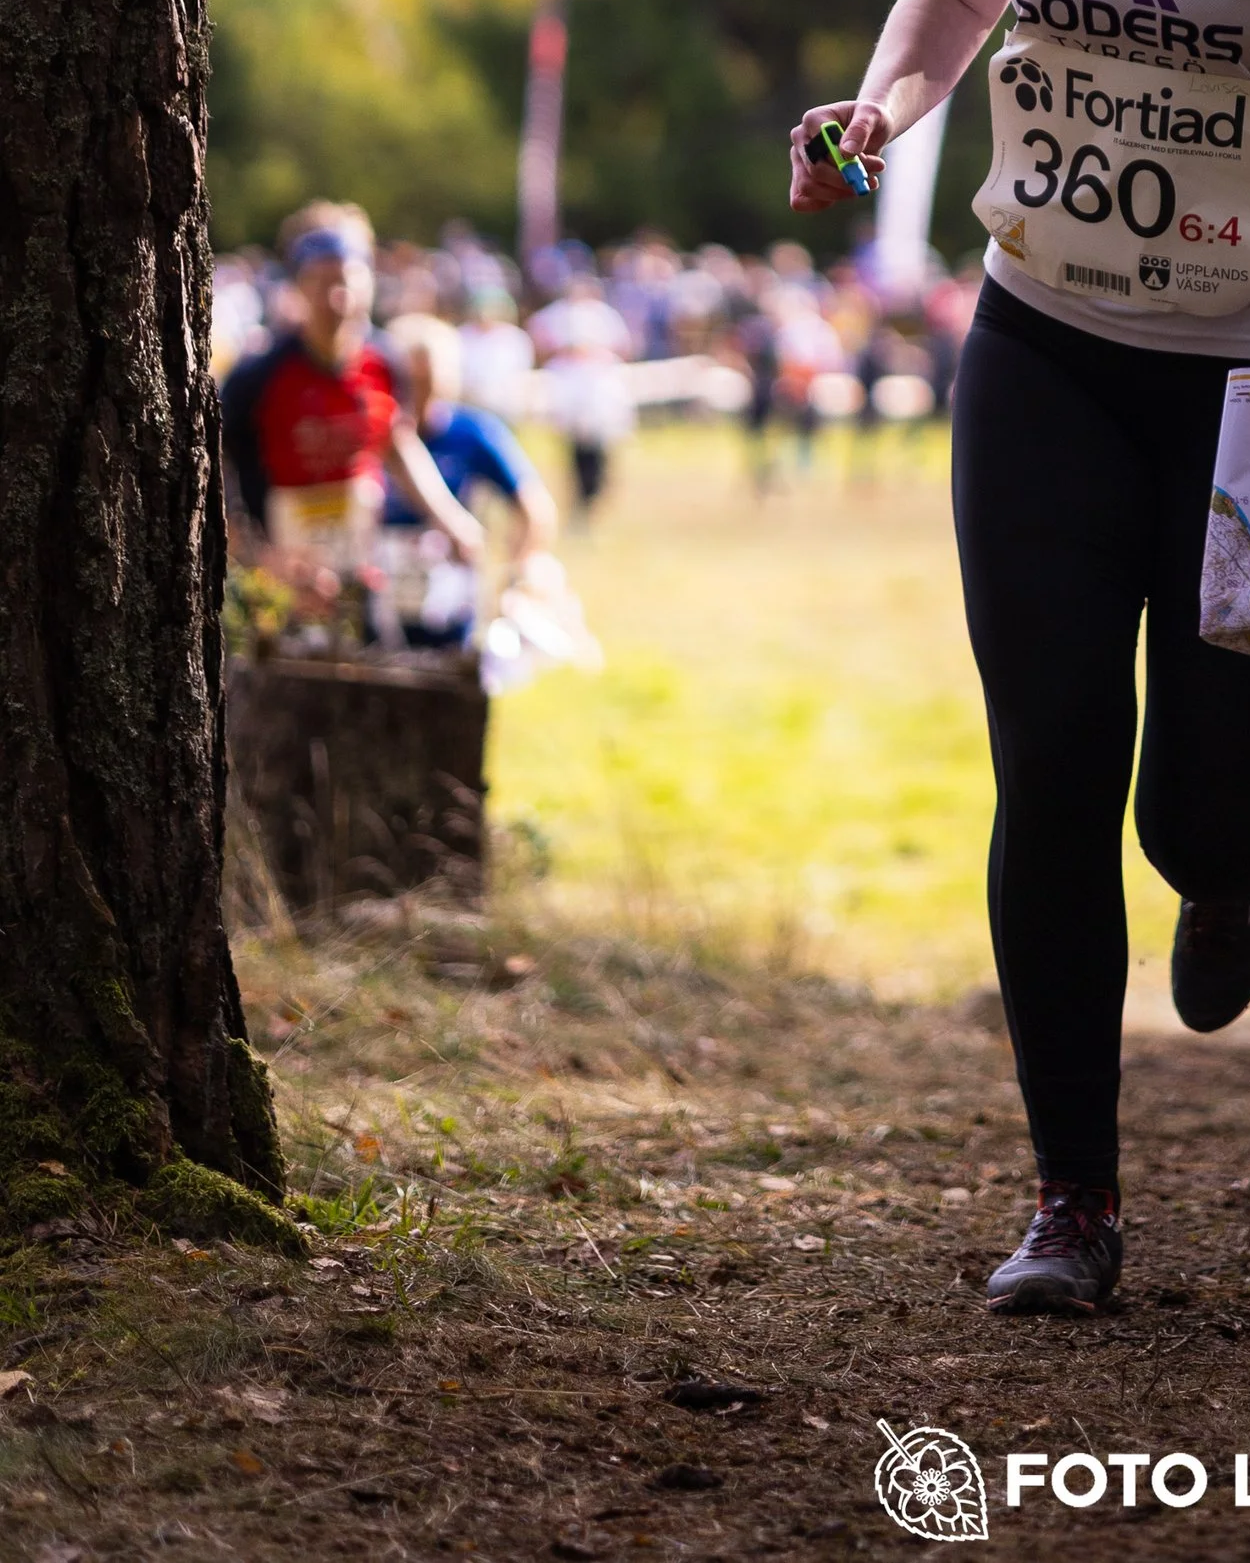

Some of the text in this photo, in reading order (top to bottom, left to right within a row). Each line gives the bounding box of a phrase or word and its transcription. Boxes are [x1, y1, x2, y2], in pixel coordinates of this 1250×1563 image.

[1066, 68, 1246, 150] Fortiad
[1151, 145, 1166, 154] MED
[1167, 147, 1214, 158] EFTERLEVNAD
[1014, 128, 1176, 239] 360
[1179, 213, 1242, 246] 6:4
[1176, 262, 1249, 282] UPPLANDS
[1176, 278, 1220, 294] VÄSBY
